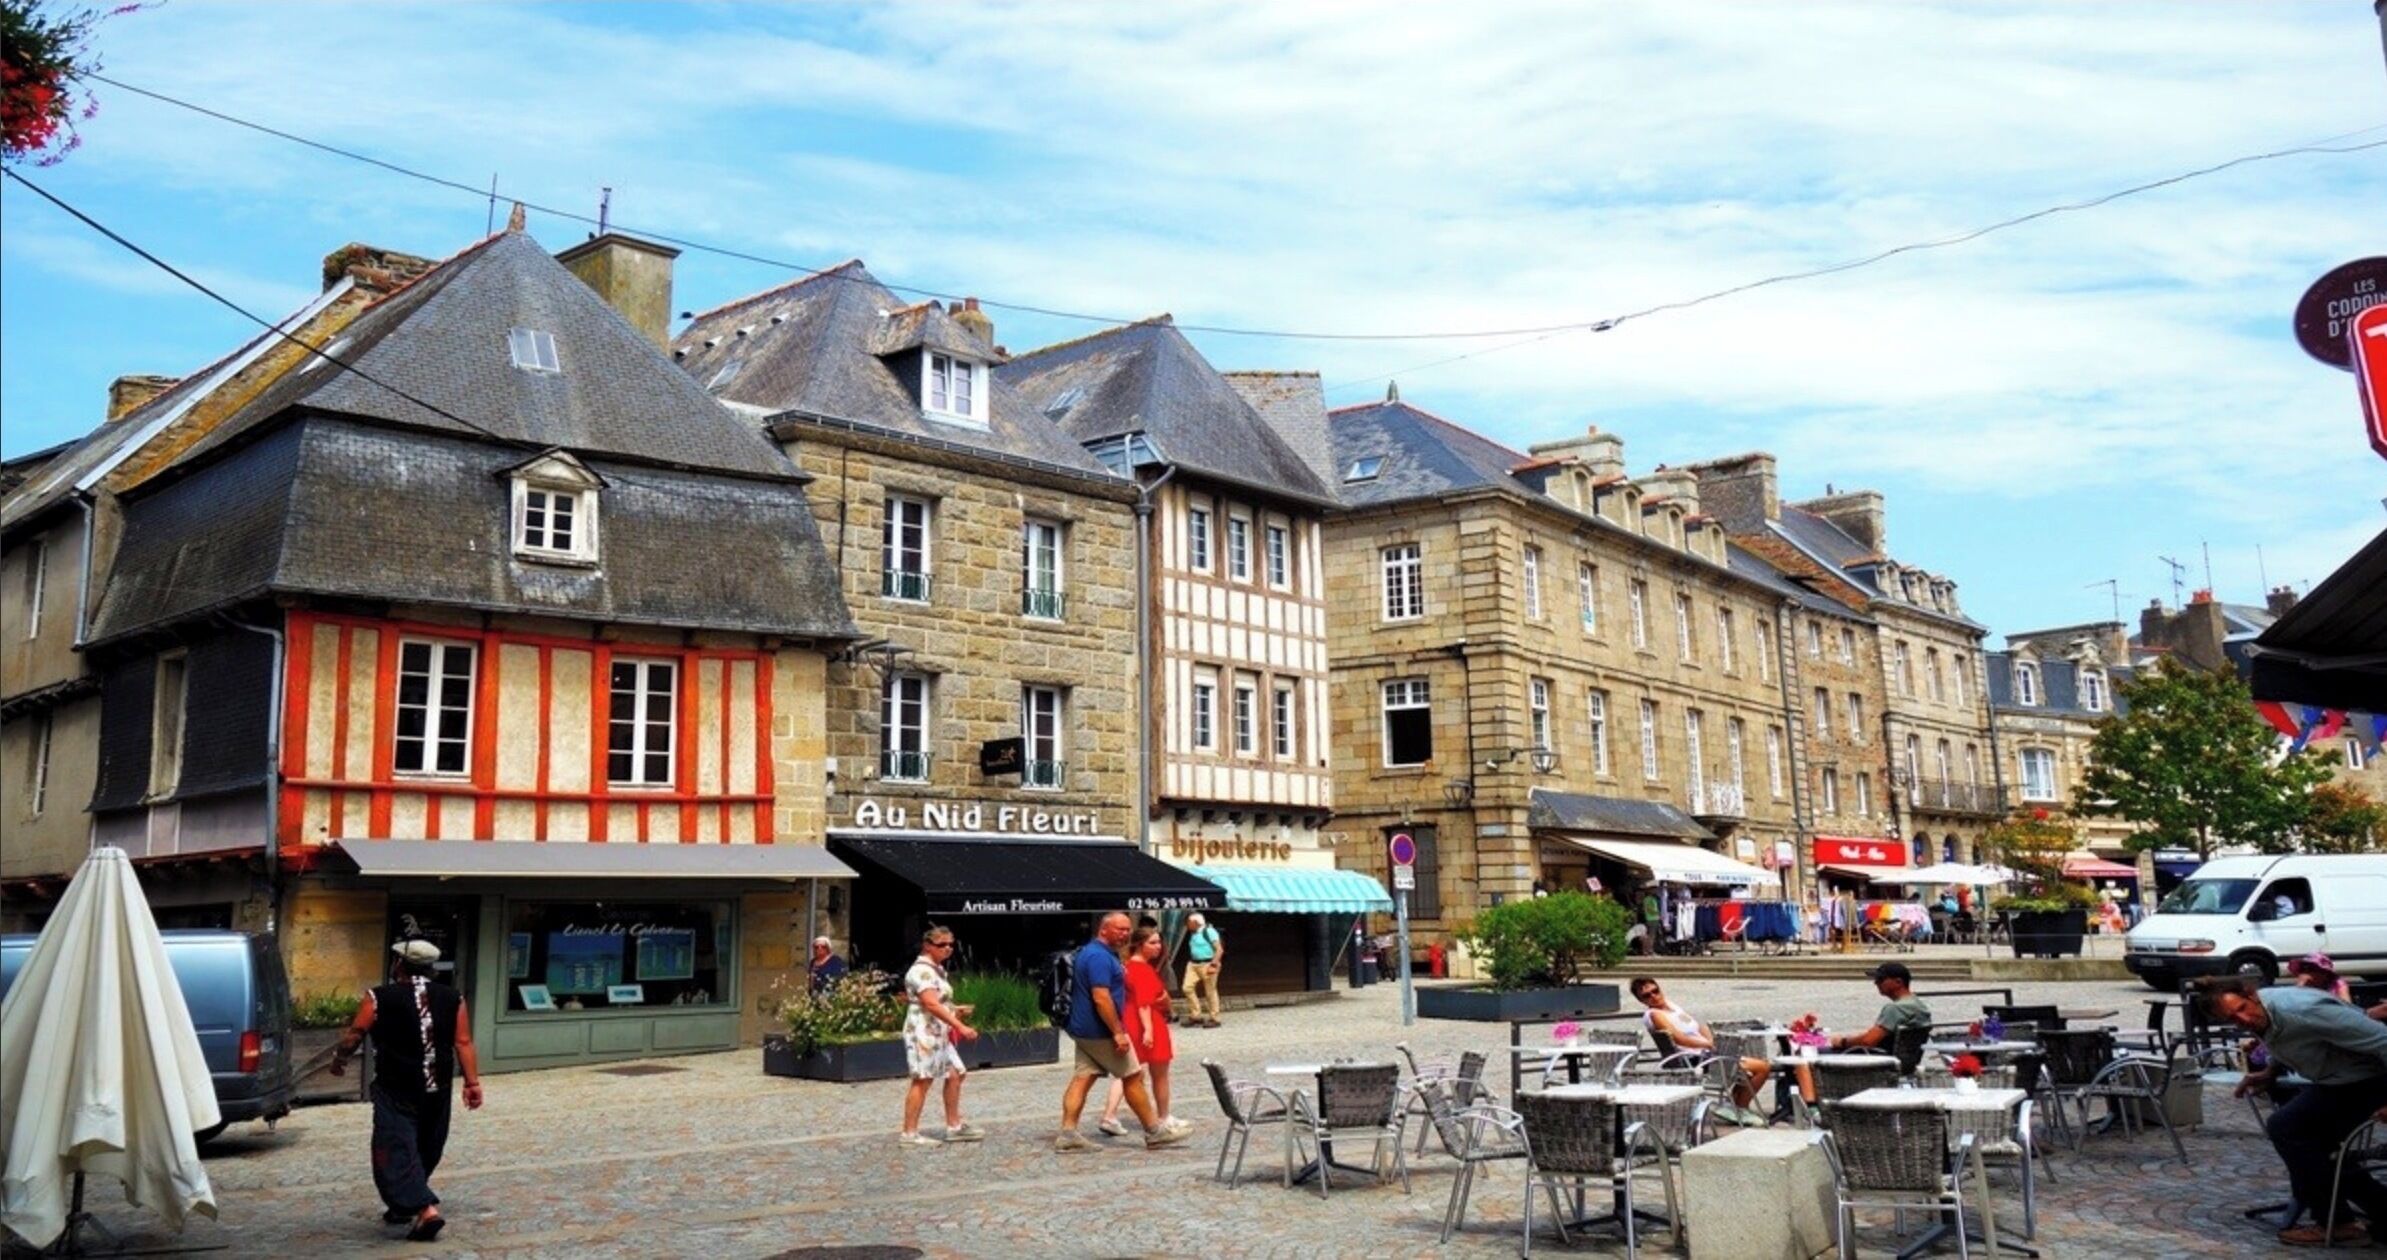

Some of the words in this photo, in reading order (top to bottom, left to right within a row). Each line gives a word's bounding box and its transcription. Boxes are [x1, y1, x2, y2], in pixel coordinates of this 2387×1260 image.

[2353, 278, 2376, 295] LES
[855, 799, 906, 828] Au
[922, 802, 982, 830] Nid
[998, 806, 1099, 834] Fleuri
[1172, 820, 1292, 865] bijouterie
[962, 898, 1007, 912] Artisan
[1010, 898, 1064, 912] Fleuriste
[1128, 897, 1142, 909] 02
[1145, 897, 1159, 909] 96
[610, 922, 626, 937] Le
